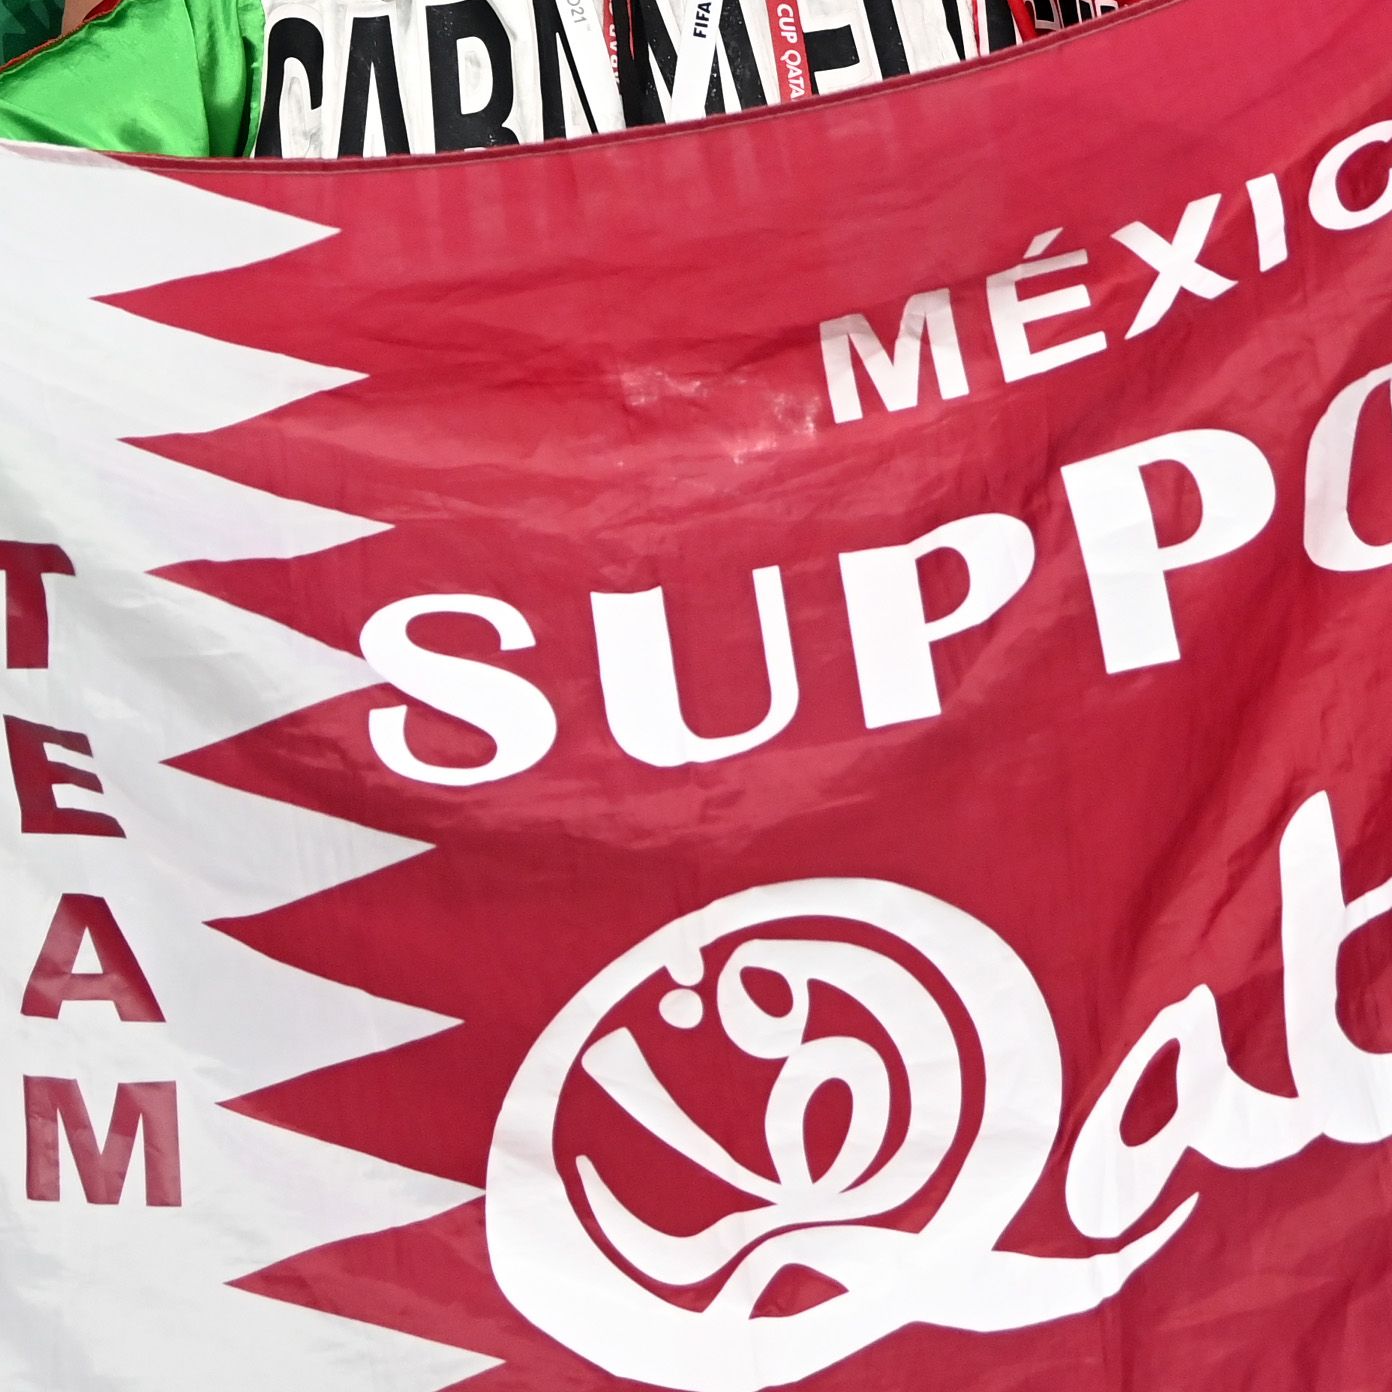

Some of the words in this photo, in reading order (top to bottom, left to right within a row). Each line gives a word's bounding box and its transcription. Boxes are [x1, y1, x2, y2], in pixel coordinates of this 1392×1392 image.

[693, 2, 712, 38] FIFA
[776, 1, 799, 44] CUP
[781, 49, 806, 102] QATA
